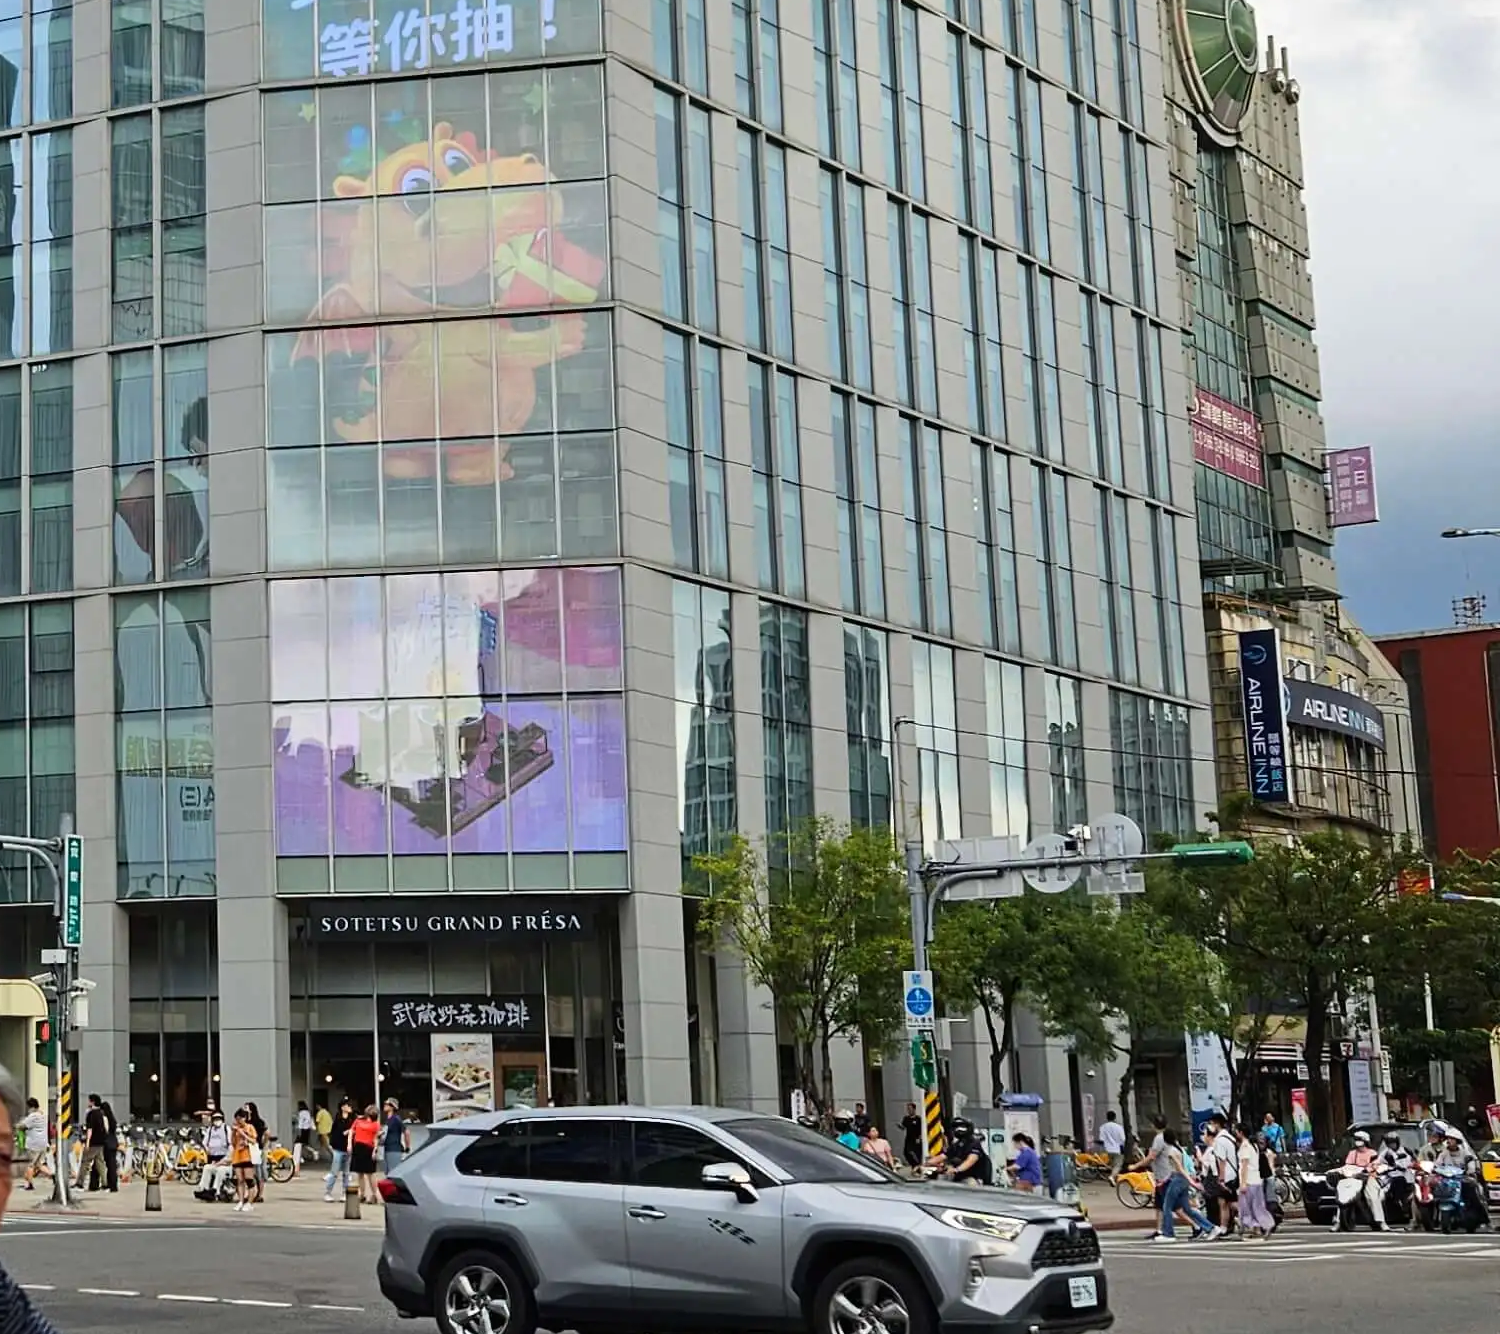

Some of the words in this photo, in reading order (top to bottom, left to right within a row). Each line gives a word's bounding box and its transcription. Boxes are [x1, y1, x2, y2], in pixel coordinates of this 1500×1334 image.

[1247, 677, 1267, 756] AIRLINE
[1303, 698, 1349, 727] AIRLINE
[1254, 758, 1269, 794] INN
[321, 916, 418, 932] SOTETSU
[427, 915, 503, 931] GRAND
